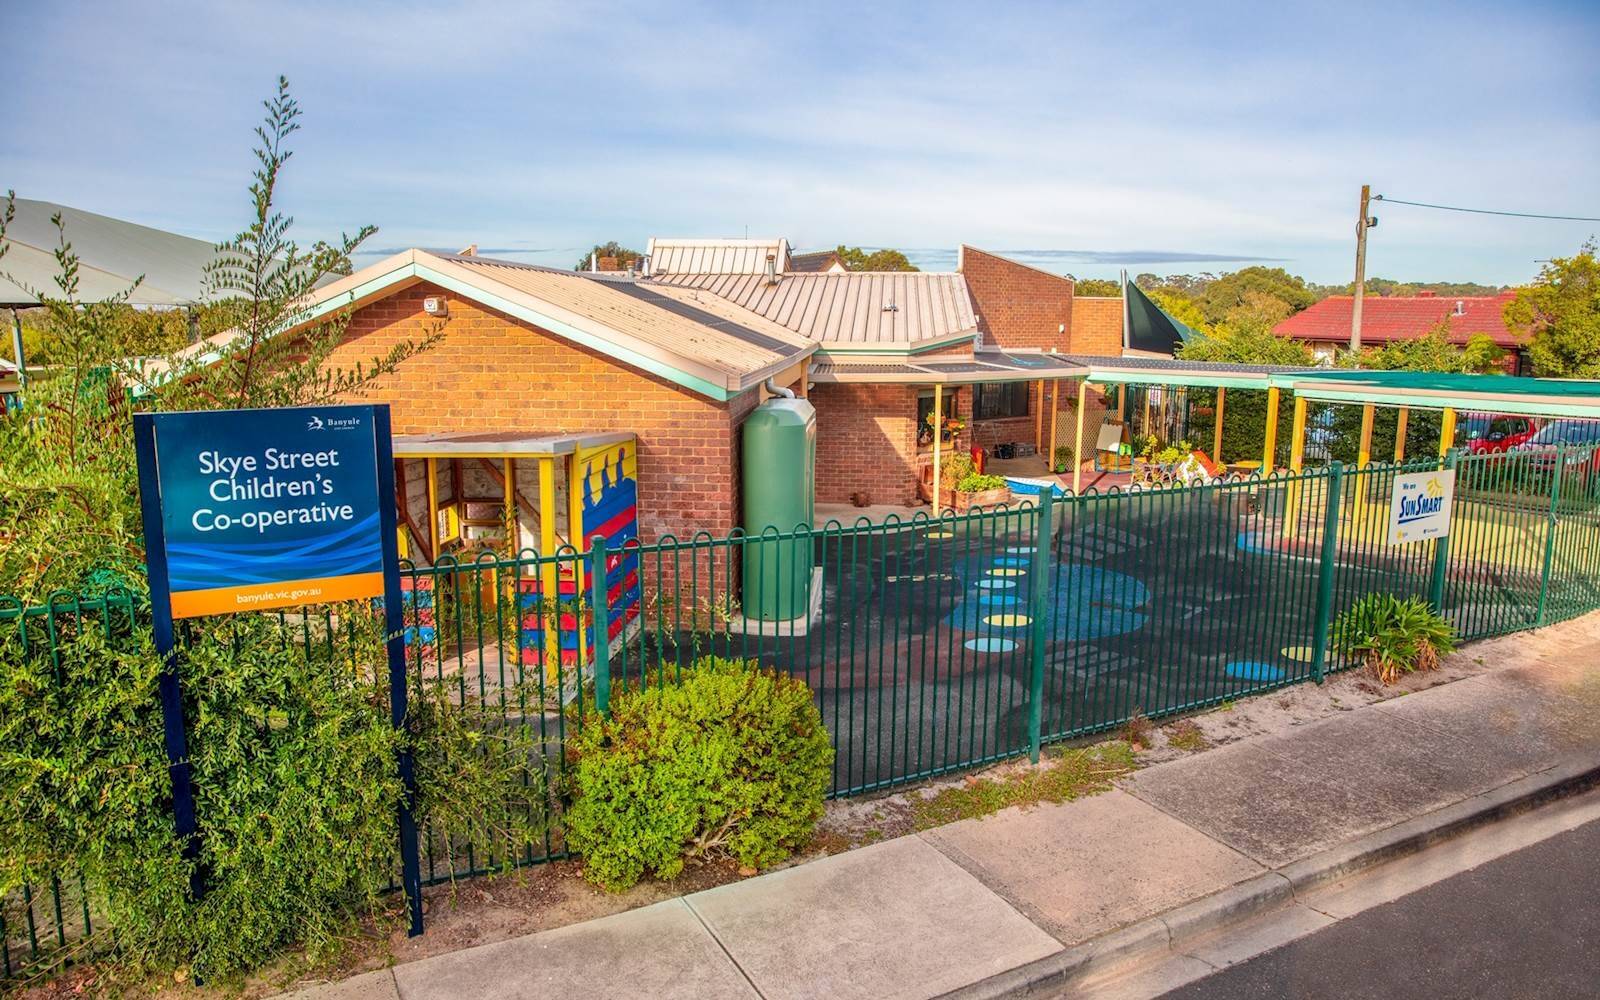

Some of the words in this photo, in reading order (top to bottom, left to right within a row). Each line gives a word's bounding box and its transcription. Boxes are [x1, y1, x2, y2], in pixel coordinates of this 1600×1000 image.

[327, 417, 361, 427] Banyule
[199, 451, 257, 478] Skye
[265, 448, 339, 470] Street
[209, 473, 333, 502] Children's
[192, 502, 353, 533] Co-operative
[236, 588, 321, 604] banyule.vic.gov.au
